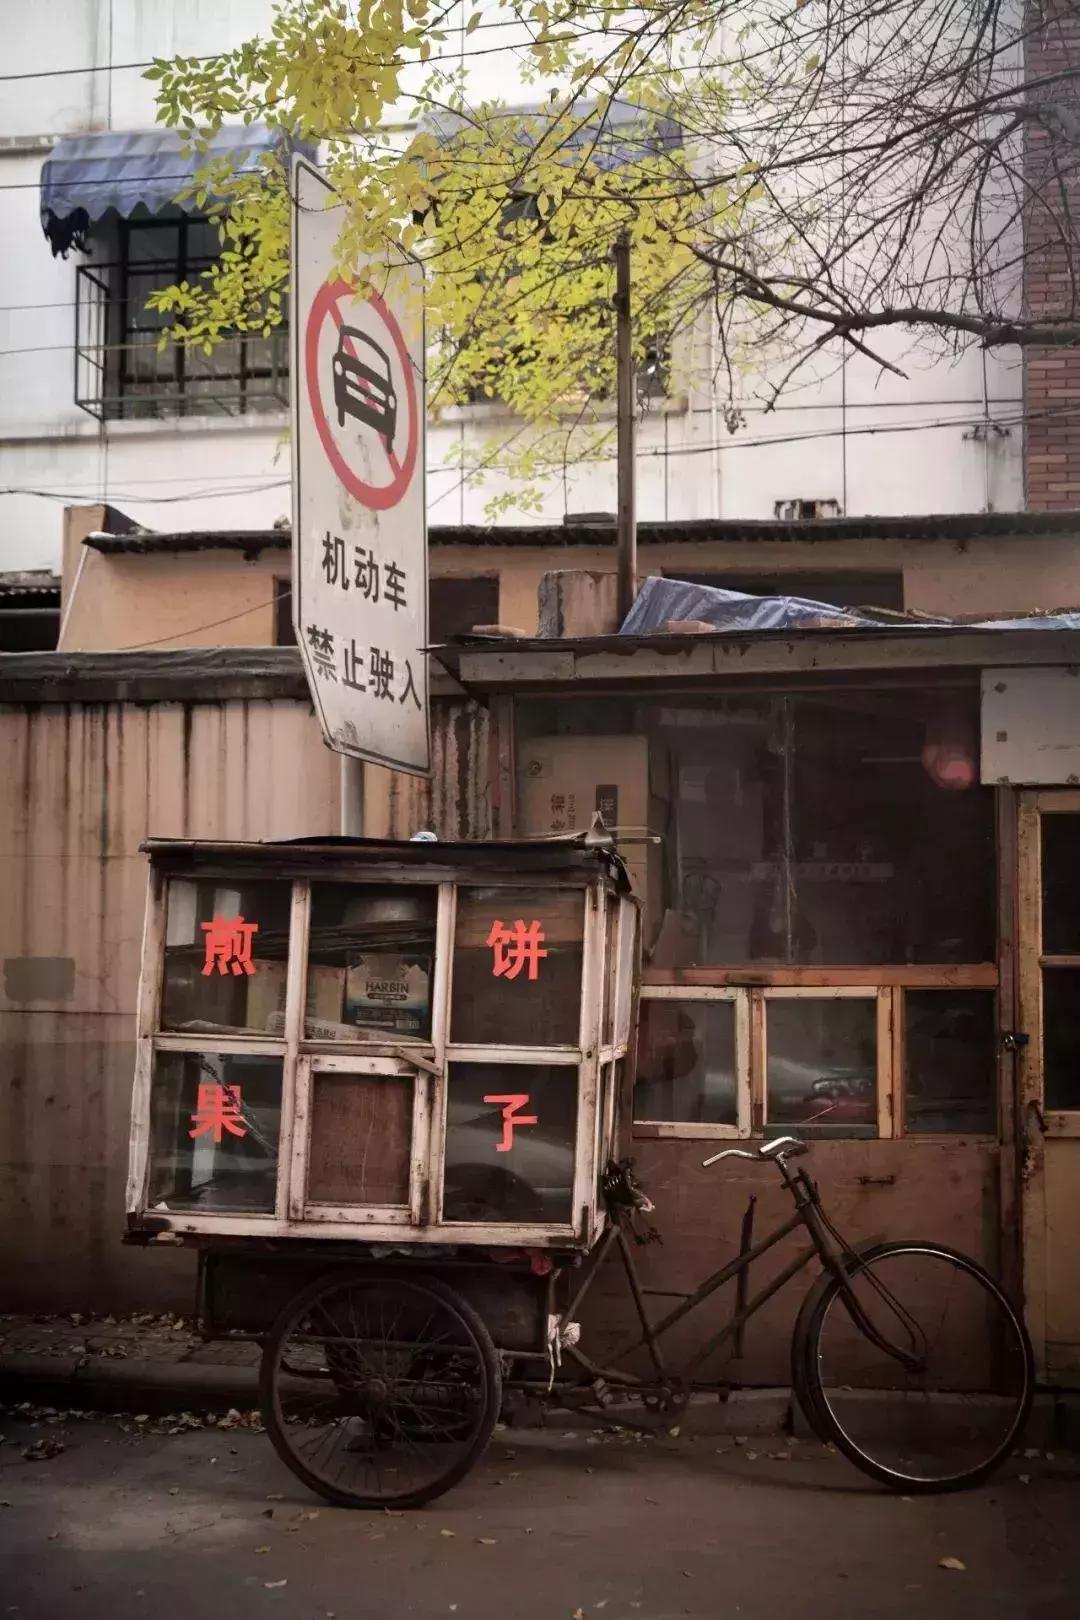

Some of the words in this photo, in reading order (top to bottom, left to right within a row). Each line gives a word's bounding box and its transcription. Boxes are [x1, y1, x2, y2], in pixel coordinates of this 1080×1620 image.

[322, 531, 407, 611] 机动车
[307, 624, 422, 711] 禁止驶入
[201, 914, 258, 976] 煎
[486, 920, 547, 980] 饼
[365, 981, 409, 994] HARBIN
[189, 1085, 248, 1142] 果
[483, 1094, 538, 1151] 子
